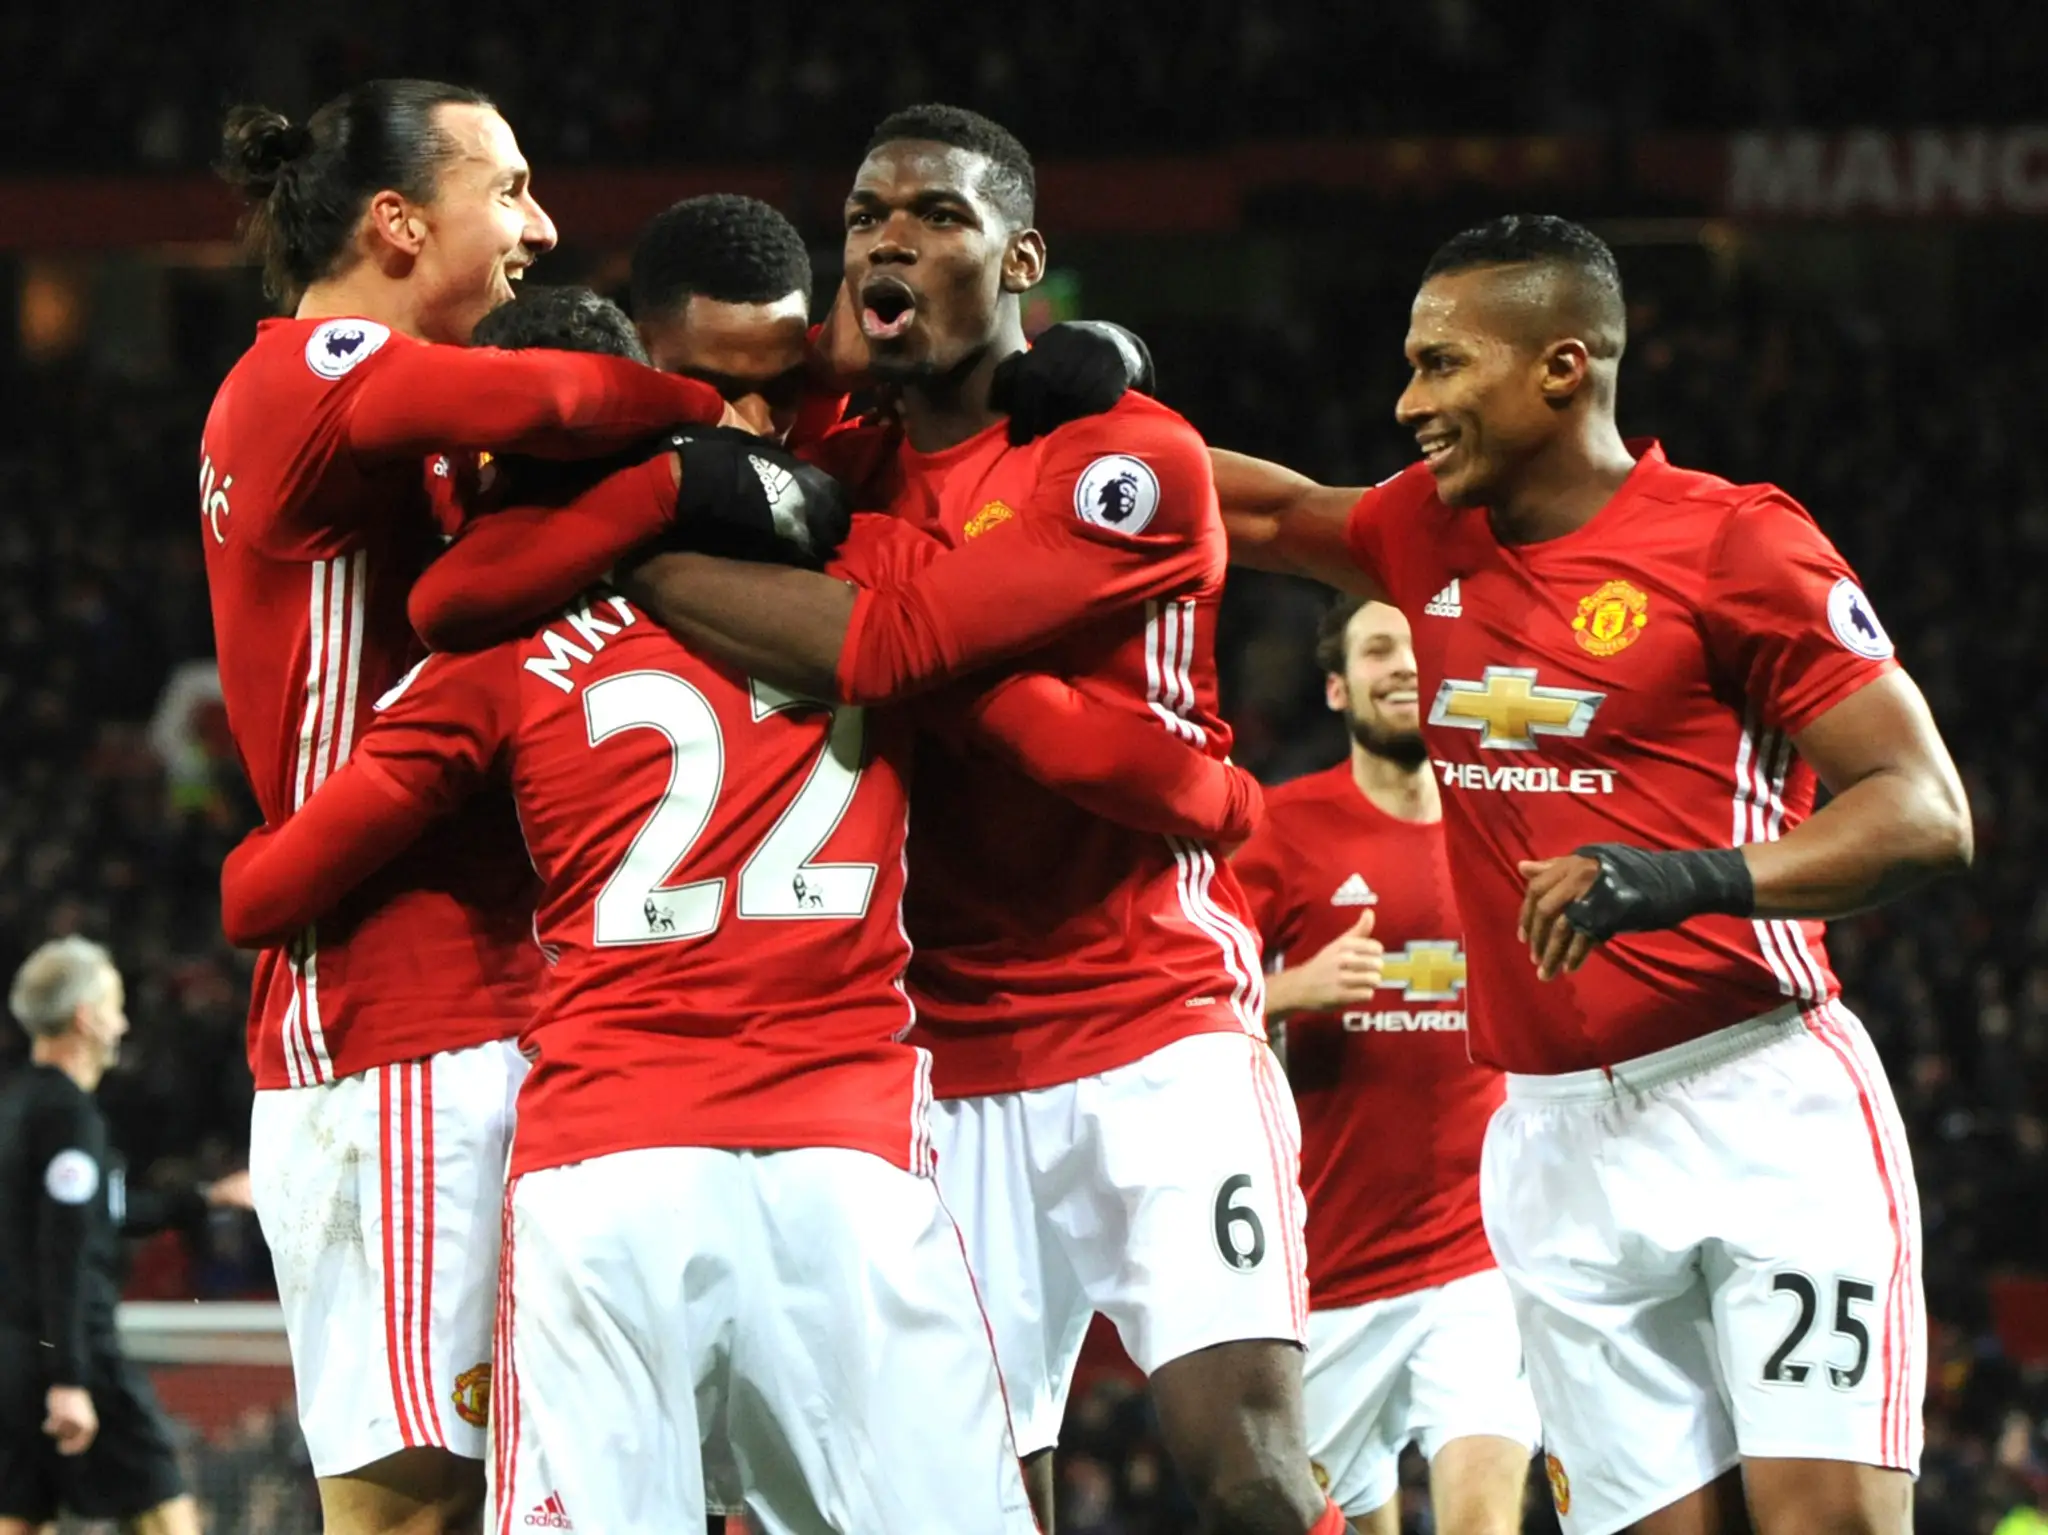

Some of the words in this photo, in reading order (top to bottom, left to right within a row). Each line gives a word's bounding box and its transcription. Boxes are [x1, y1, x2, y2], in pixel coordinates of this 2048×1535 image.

[583, 669, 879, 947] 22
[1213, 1172, 1266, 1271] 6
[1761, 1270, 1875, 1391] 25
